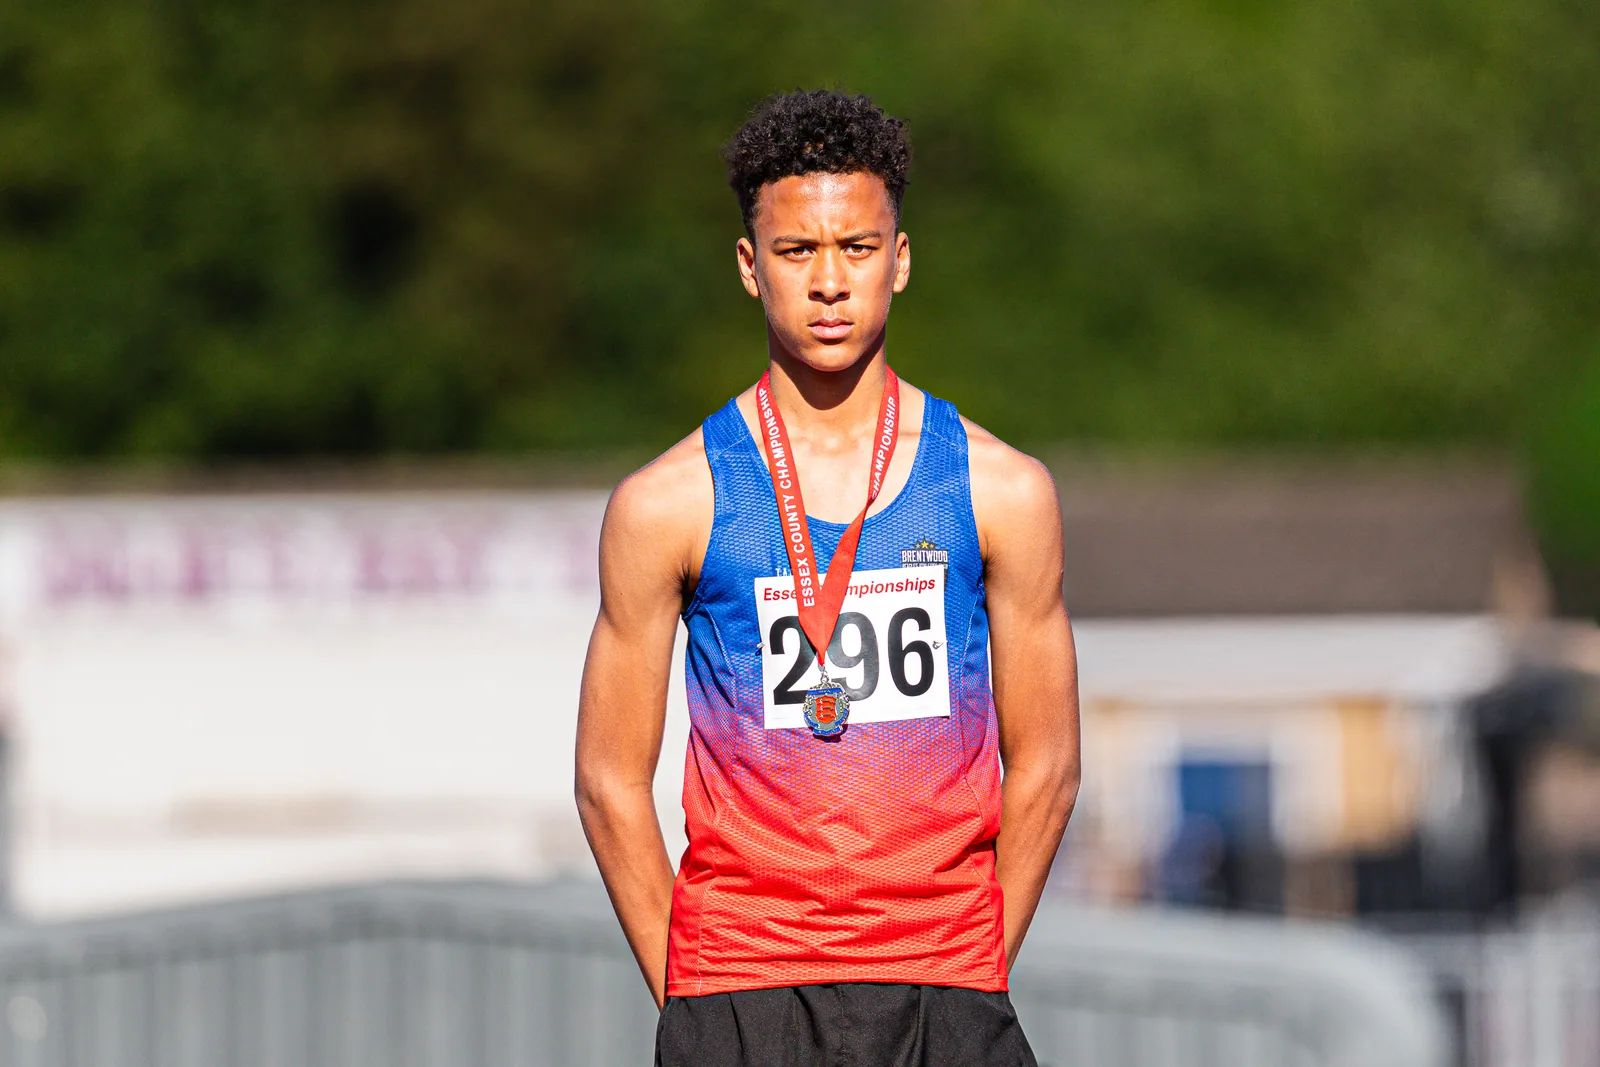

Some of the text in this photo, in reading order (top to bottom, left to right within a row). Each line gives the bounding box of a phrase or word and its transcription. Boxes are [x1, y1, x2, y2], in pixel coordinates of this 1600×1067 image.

[758, 387, 815, 607] ESSEX COUNTY CHAMPIONSHIP
[901, 550, 948, 563] BRENTWOOD
[763, 587, 798, 601] Esse
[769, 606, 935, 705] 296
